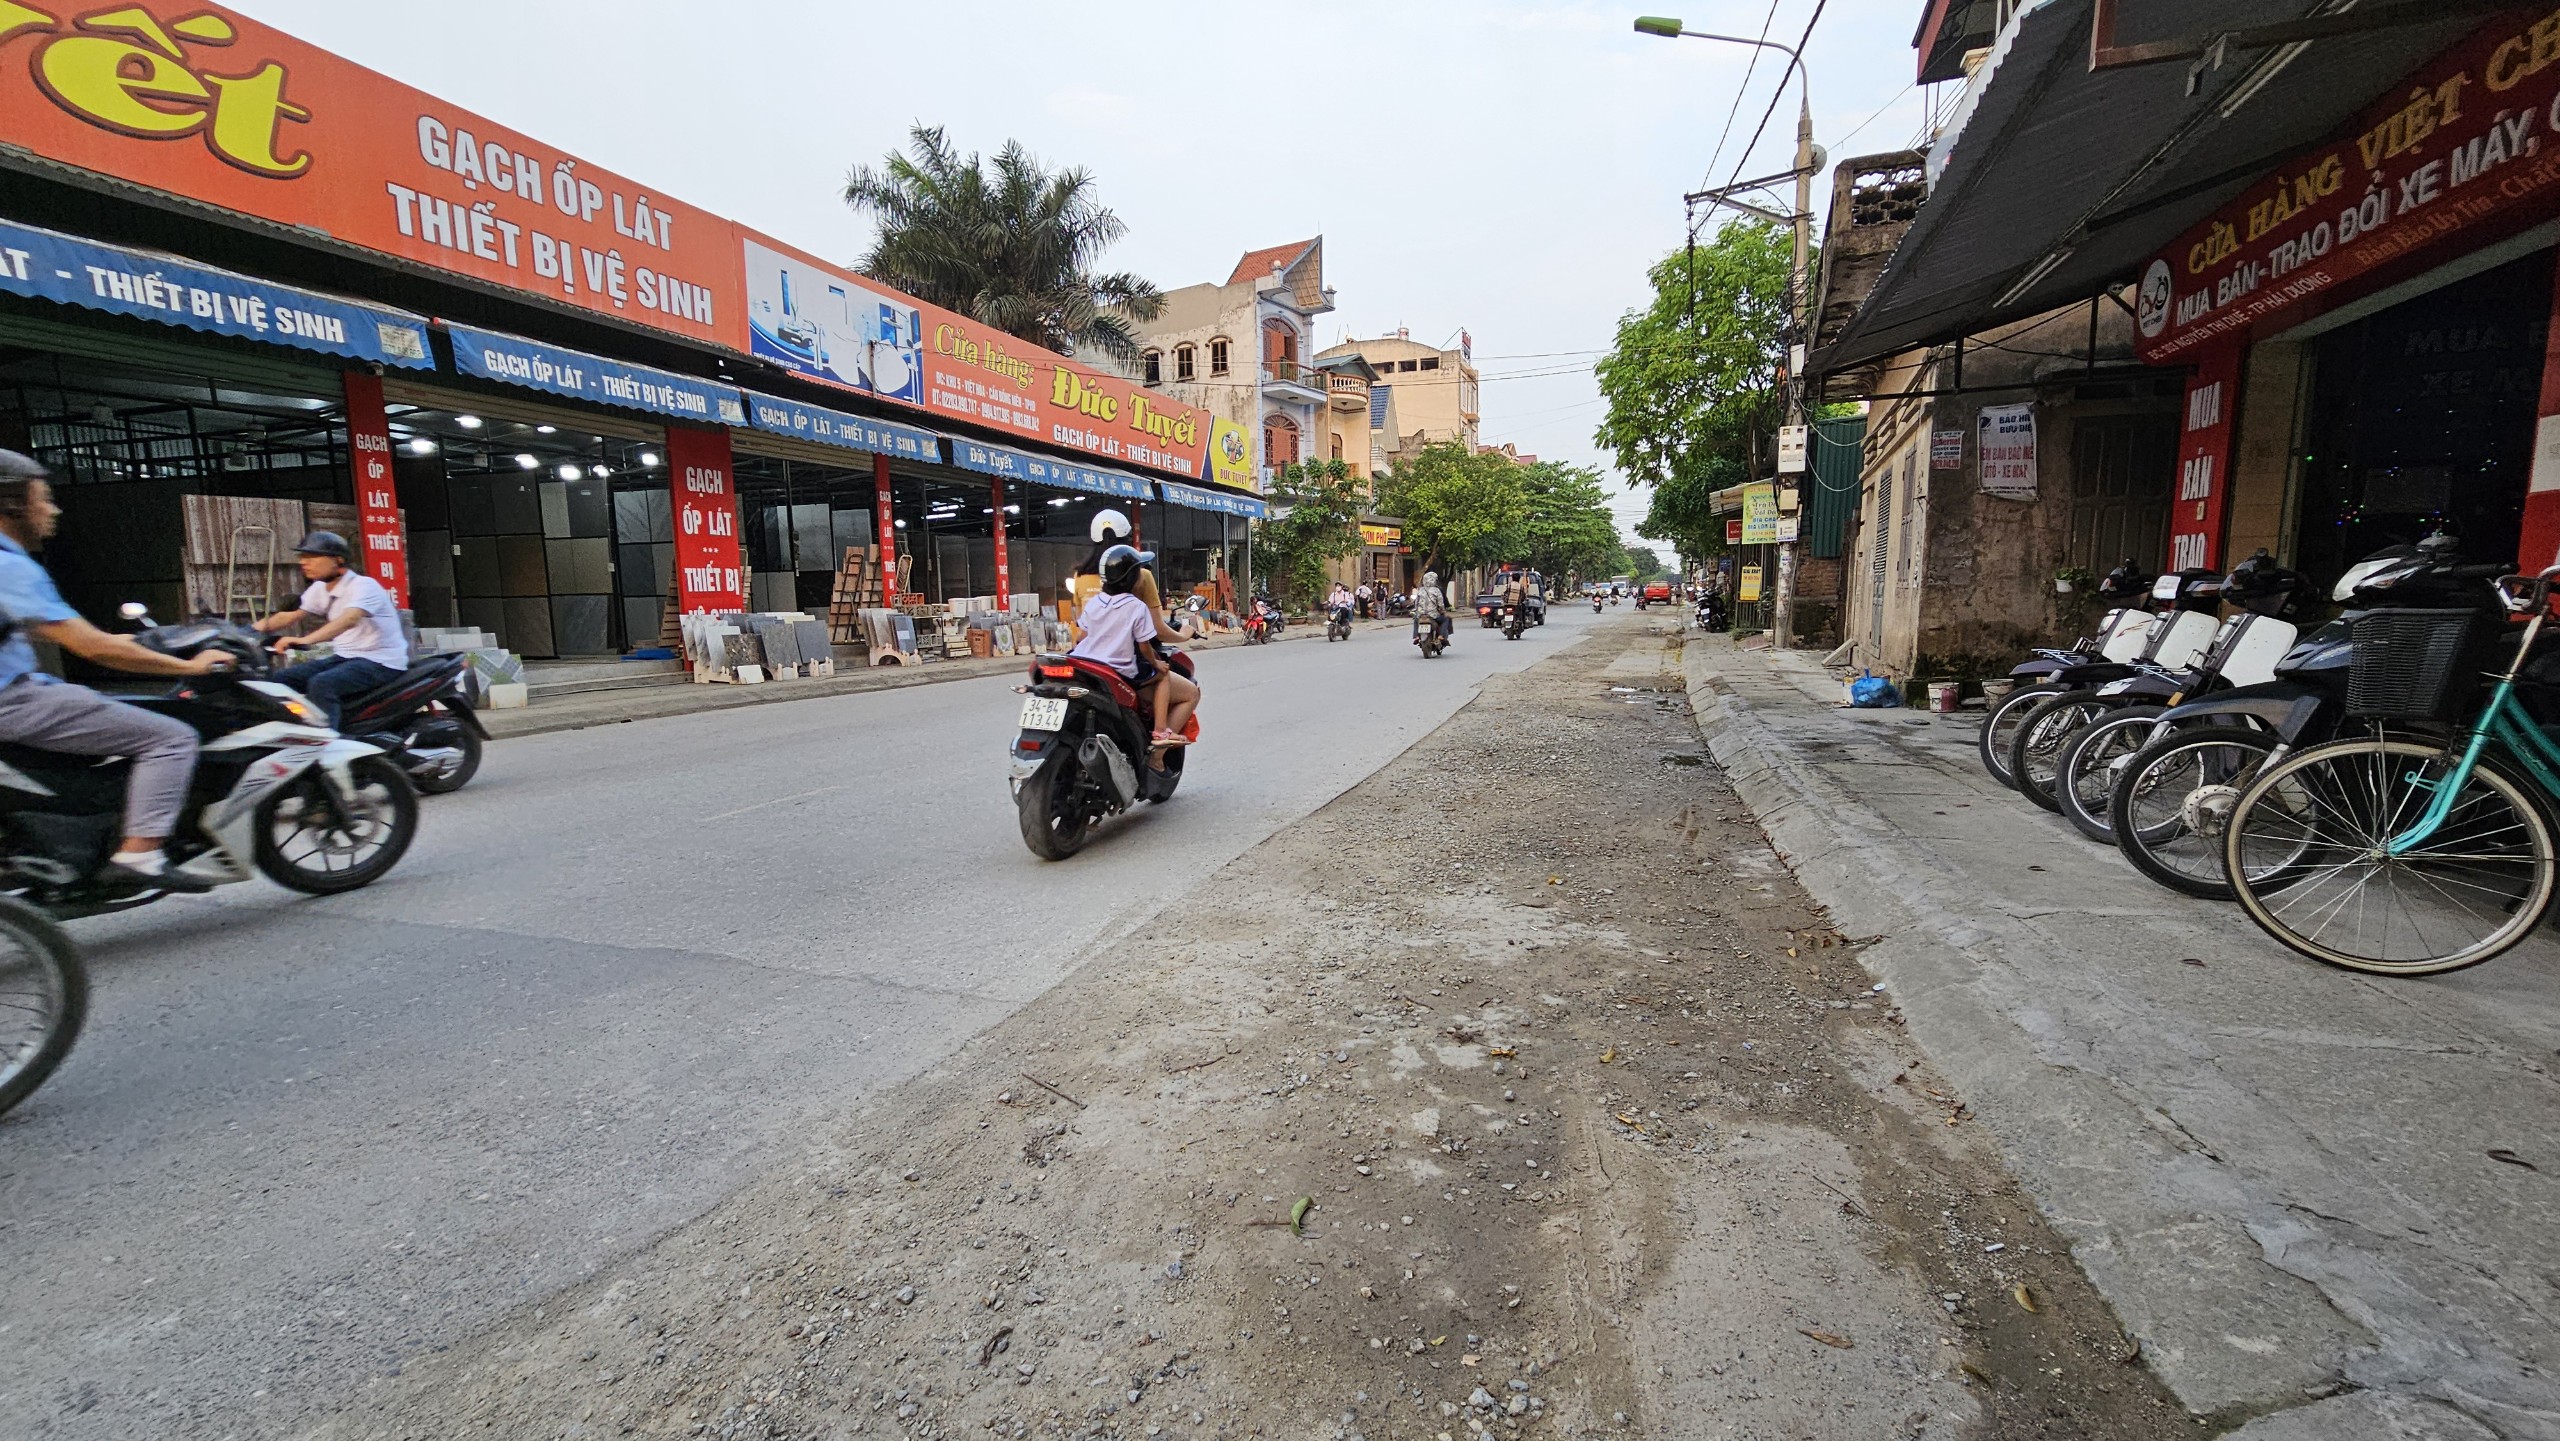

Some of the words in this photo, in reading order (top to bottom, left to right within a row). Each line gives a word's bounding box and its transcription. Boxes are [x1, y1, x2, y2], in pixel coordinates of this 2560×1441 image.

[0, 0, 312, 176] ết
[416, 114, 544, 206] GẠCH
[551, 159, 604, 224] ỐP
[612, 191, 673, 251] LÁT
[2188, 220, 2242, 274] CỬA
[2247, 153, 2346, 243] HÀNG
[2355, 71, 2473, 171] VIỆT
[386, 182, 521, 269] THIẾT
[531, 230, 576, 296] BỊ
[580, 247, 628, 309] VỆ
[635, 264, 714, 326] SINH
[2176, 287, 2213, 327] MUA
[2338, 170, 2392, 246] ĐỔI
[2397, 158, 2445, 216] XE
[85, 264, 186, 313] THIẾT
[188, 288, 225, 325] BỊ
[230, 294, 270, 333] VỆ
[275, 306, 345, 344] SINH
[2174, 320, 2212, 352] NGUYỄN
[2207, 313, 2229, 338] THỊ
[2248, 300, 2267, 315] TP
[2285, 271, 2333, 299] DƯƠNG
[934, 322, 979, 368] Cửa
[982, 339, 1035, 391] hàng:
[483, 349, 530, 378] GẠCH
[532, 354, 552, 383] ỐP
[556, 364, 583, 390] LÁT
[601, 373, 642, 402] THIẾT
[644, 382, 657, 408] BỊ
[657, 385, 675, 412] VỆ
[676, 391, 707, 414] SINH
[1050, 363, 1119, 423] Đức
[1128, 391, 1198, 449] Tuyết
[1999, 413, 2017, 425] BẢO
[2187, 381, 2221, 432] MUA
[355, 433, 388, 453] GẠCH
[759, 405, 789, 429] GẠCH
[793, 408, 808, 431] ỐP
[813, 417, 831, 435] LÁT
[839, 423, 863, 443] THIẾT
[867, 430, 878, 448] BỊ
[881, 431, 893, 450] VỆ
[896, 435, 917, 453] SINH
[1053, 423, 1084, 448] GẠCH
[1085, 428, 1100, 451] ỐP
[1101, 435, 1120, 456] LÁT
[1126, 443, 1151, 464] THIẾT
[1152, 452, 1161, 472] BỊ
[1162, 452, 1173, 472] VỆ
[1173, 456, 1192, 474] SINH
[1999, 424, 2018, 434] BƯU
[2019, 424, 2033, 434] ĐIỆ
[367, 457, 384, 479] ỐP
[686, 466, 724, 498] GẠCH
[969, 447, 986, 466] Đức
[989, 450, 1014, 471] Tuyết
[1029, 462, 1046, 478] GẠCH
[1052, 464, 1060, 479] ỐP
[1220, 468, 1231, 481] ĐỨC
[1232, 471, 1248, 486] TUYẾT
[2003, 464, 2011, 478] XE
[2180, 446, 2213, 501] BÁN
[367, 489, 389, 508] LÁT
[682, 502, 703, 535] ỐP
[708, 506, 732, 537] LÁT
[367, 530, 400, 551] THIẾT
[380, 562, 394, 580] BỊ
[684, 560, 722, 593] THIẾT
[725, 568, 740, 596] BỊ
[1029, 699, 1059, 714] 34-B4
